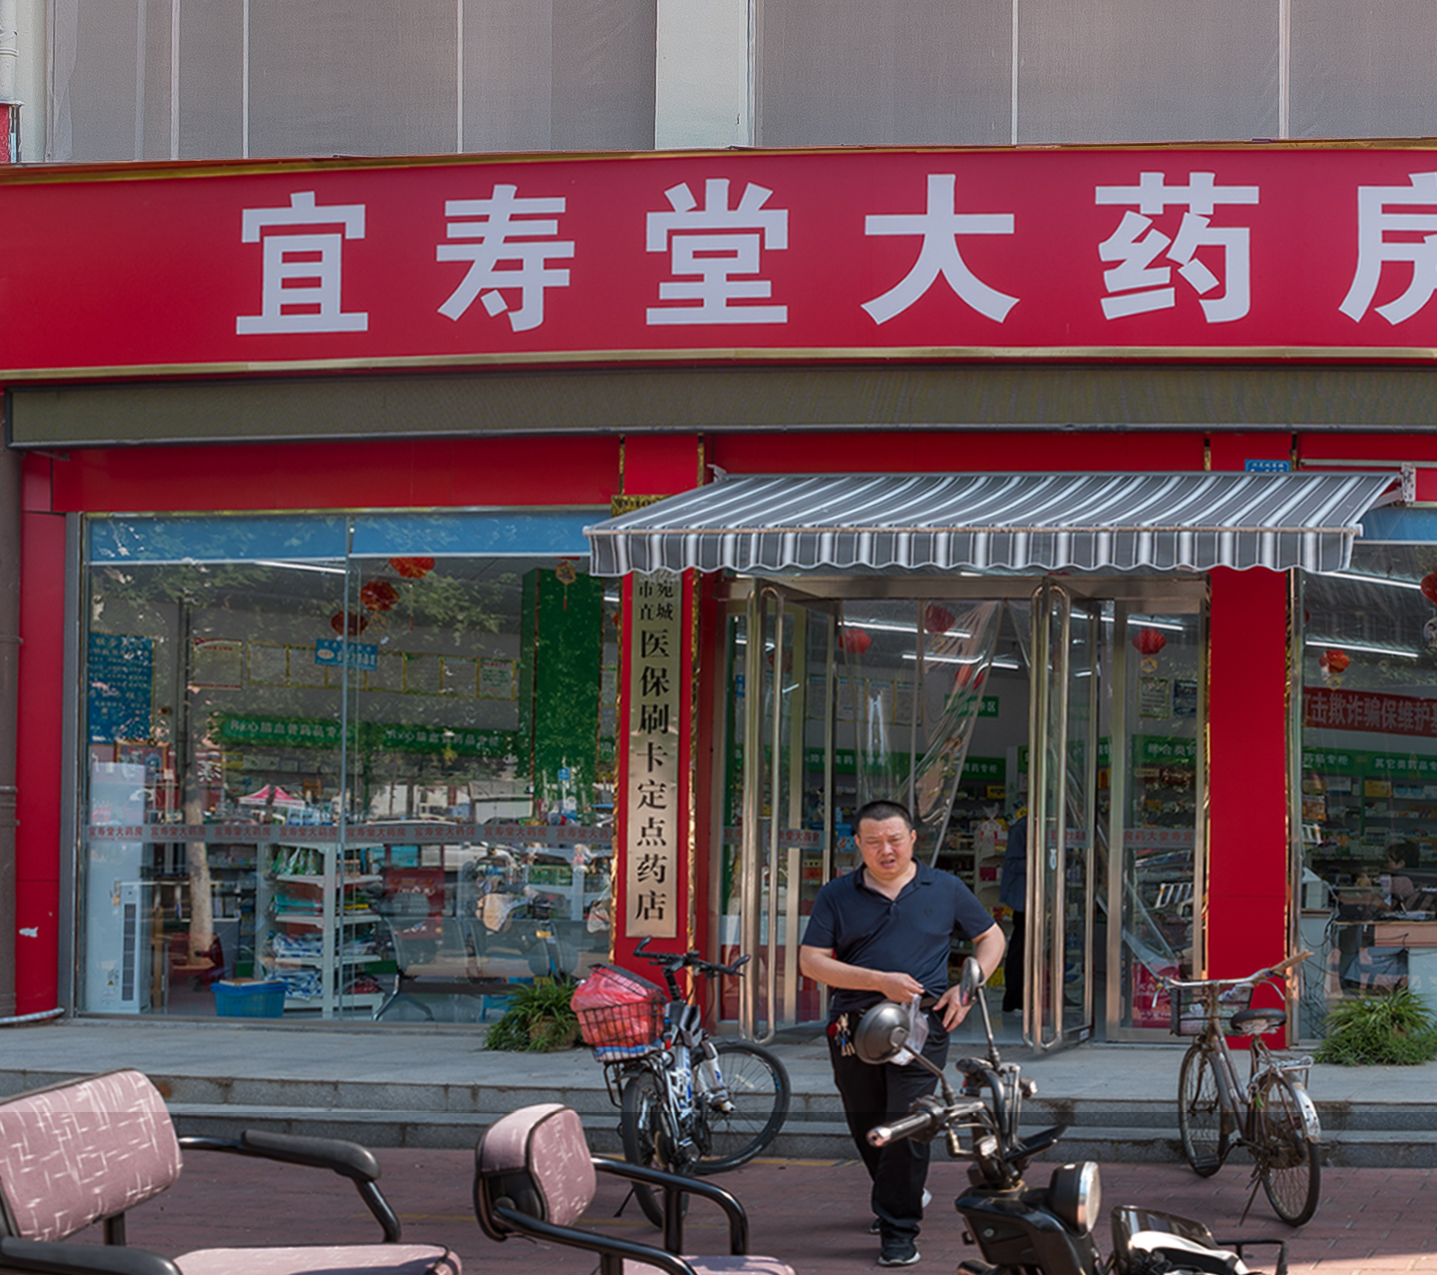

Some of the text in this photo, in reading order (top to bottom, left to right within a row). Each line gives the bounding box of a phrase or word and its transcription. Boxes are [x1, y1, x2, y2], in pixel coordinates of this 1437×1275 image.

[635, 628, 670, 921] 医保刷卡定点药店
